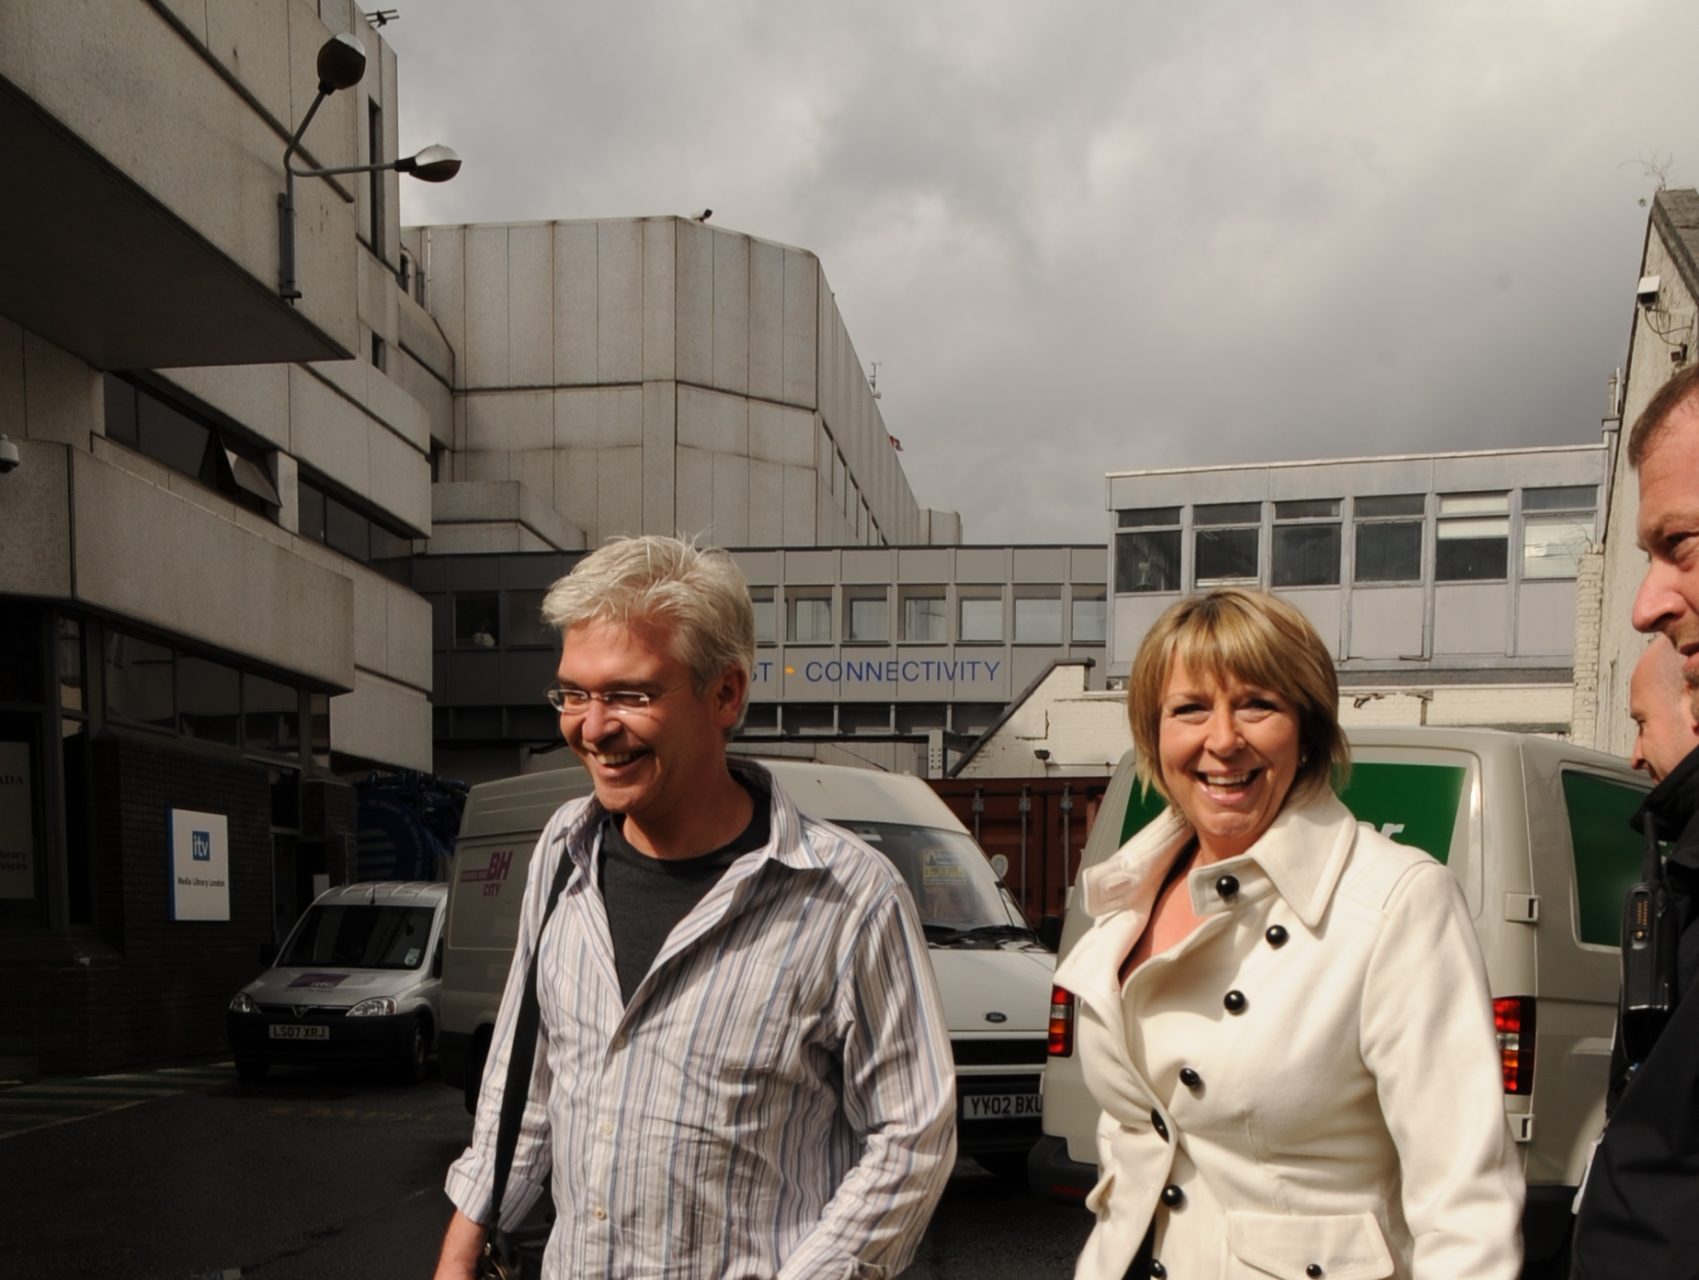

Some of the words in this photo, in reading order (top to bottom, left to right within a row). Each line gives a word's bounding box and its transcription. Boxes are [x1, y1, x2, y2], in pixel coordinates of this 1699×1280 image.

[805, 661, 1001, 682] CONNECTIVITY
[193, 834, 209, 857] itv
[273, 1026, 301, 1038] LS07
[303, 1027, 326, 1039] XRJ
[970, 1096, 1011, 1116] YY02
